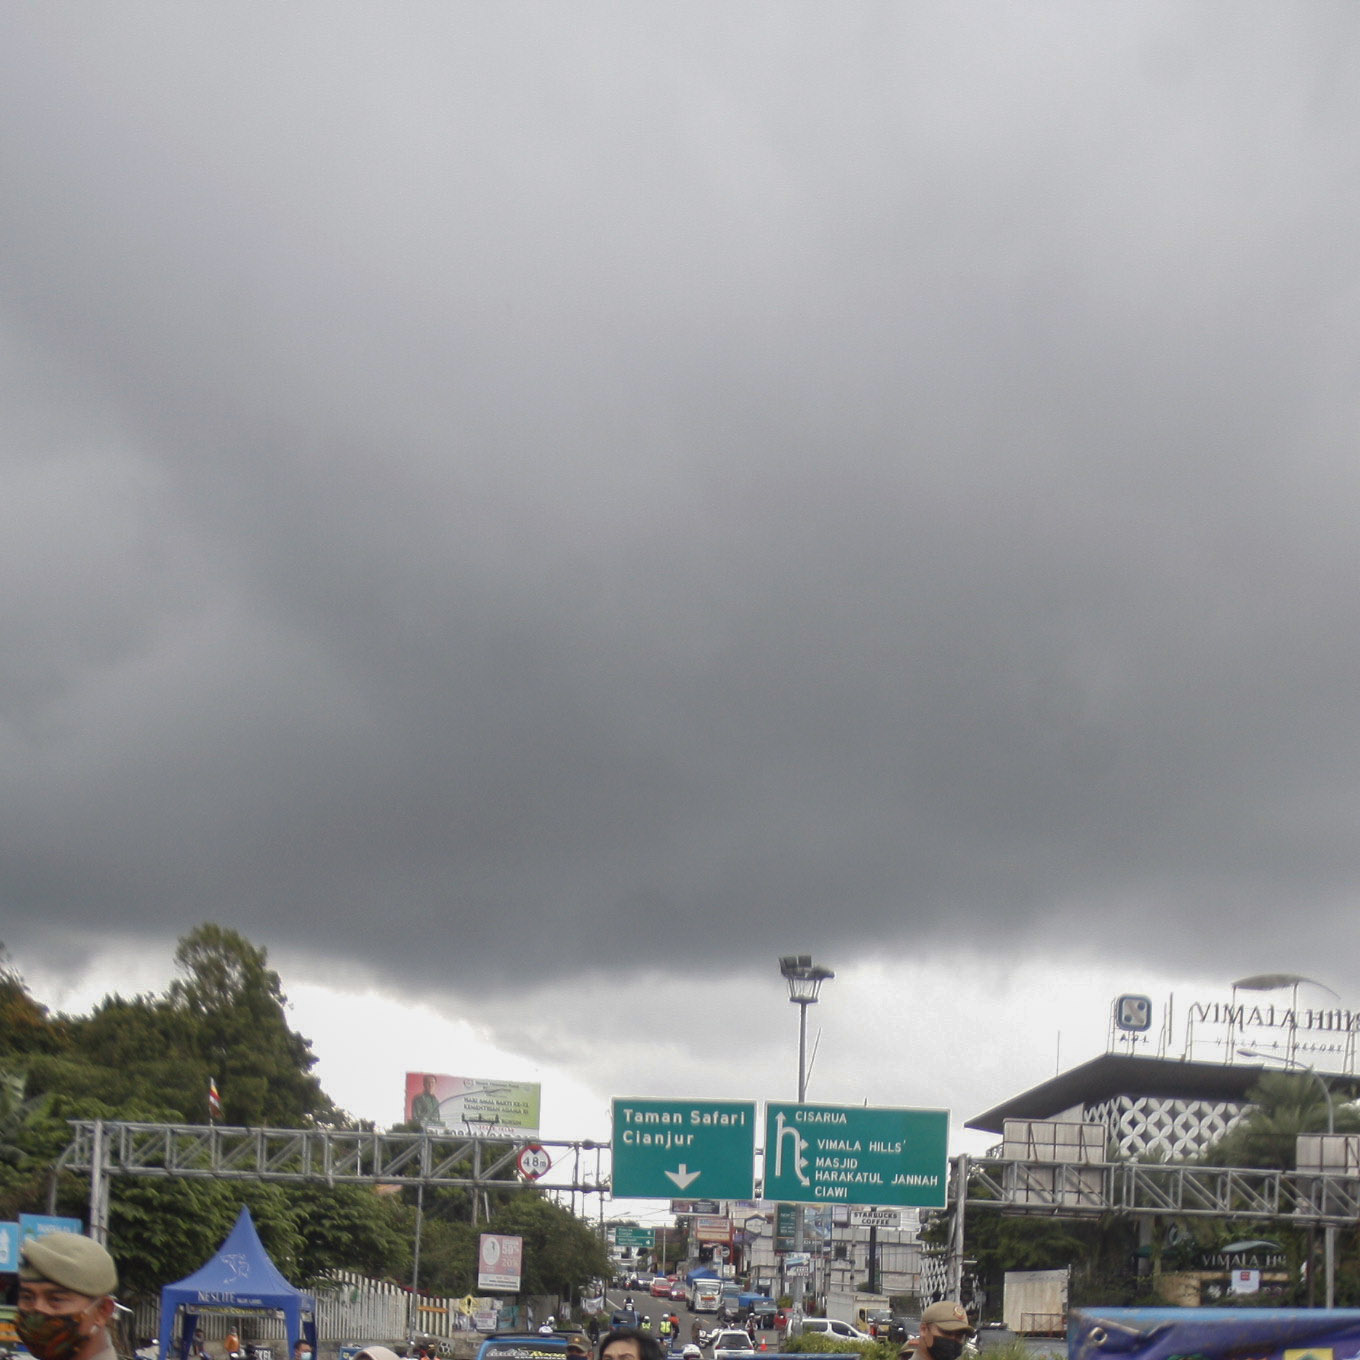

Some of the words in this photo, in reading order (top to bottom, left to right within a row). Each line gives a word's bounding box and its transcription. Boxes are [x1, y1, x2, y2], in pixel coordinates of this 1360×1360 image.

[1195, 1002, 1298, 1031] VIMALA
[623, 1109, 682, 1124] Taman
[691, 1110, 745, 1125] Safari
[795, 1111, 847, 1124] CISARUA
[622, 1130, 694, 1149] Cianjur
[817, 1138, 862, 1151] VIMALA
[815, 1157, 858, 1169] MASJID
[814, 1170, 883, 1184] HARAKATUL
[891, 1173, 938, 1186] JANNAH
[814, 1186, 848, 1198] CIAWI
[854, 1211, 898, 1220] STARBUCKS
